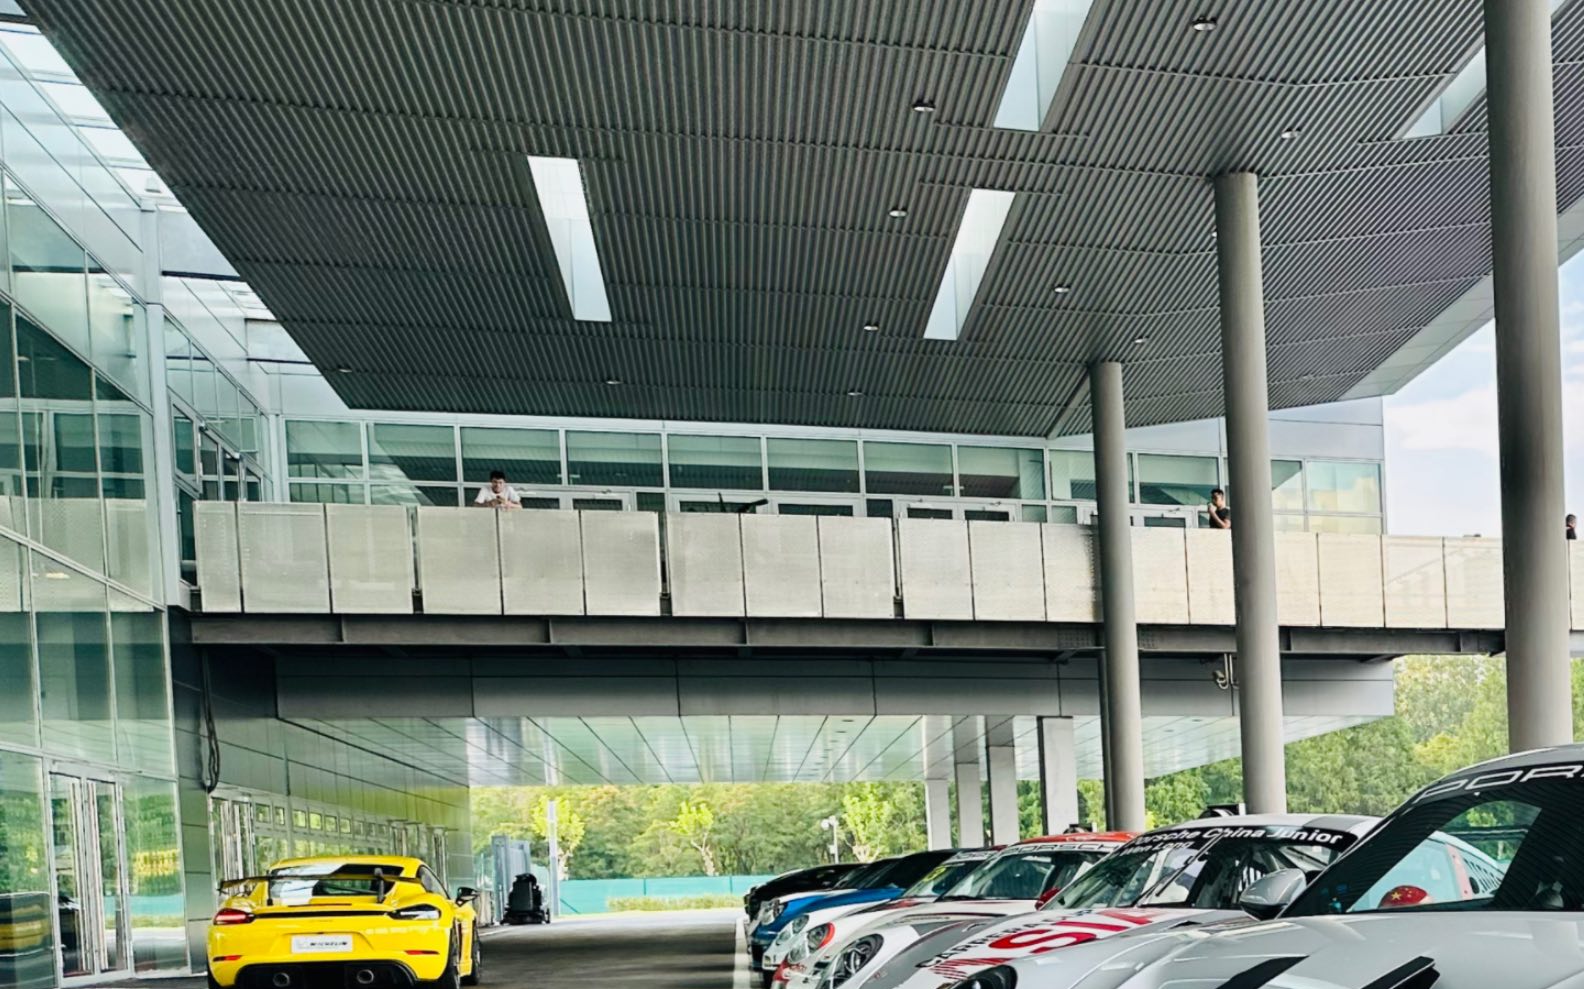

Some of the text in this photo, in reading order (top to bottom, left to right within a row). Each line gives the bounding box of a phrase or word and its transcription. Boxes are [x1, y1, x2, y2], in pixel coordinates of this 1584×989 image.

[1202, 827, 1264, 839] China
[1266, 828, 1344, 844] Junior
[1006, 843, 1120, 856] PORSCH
